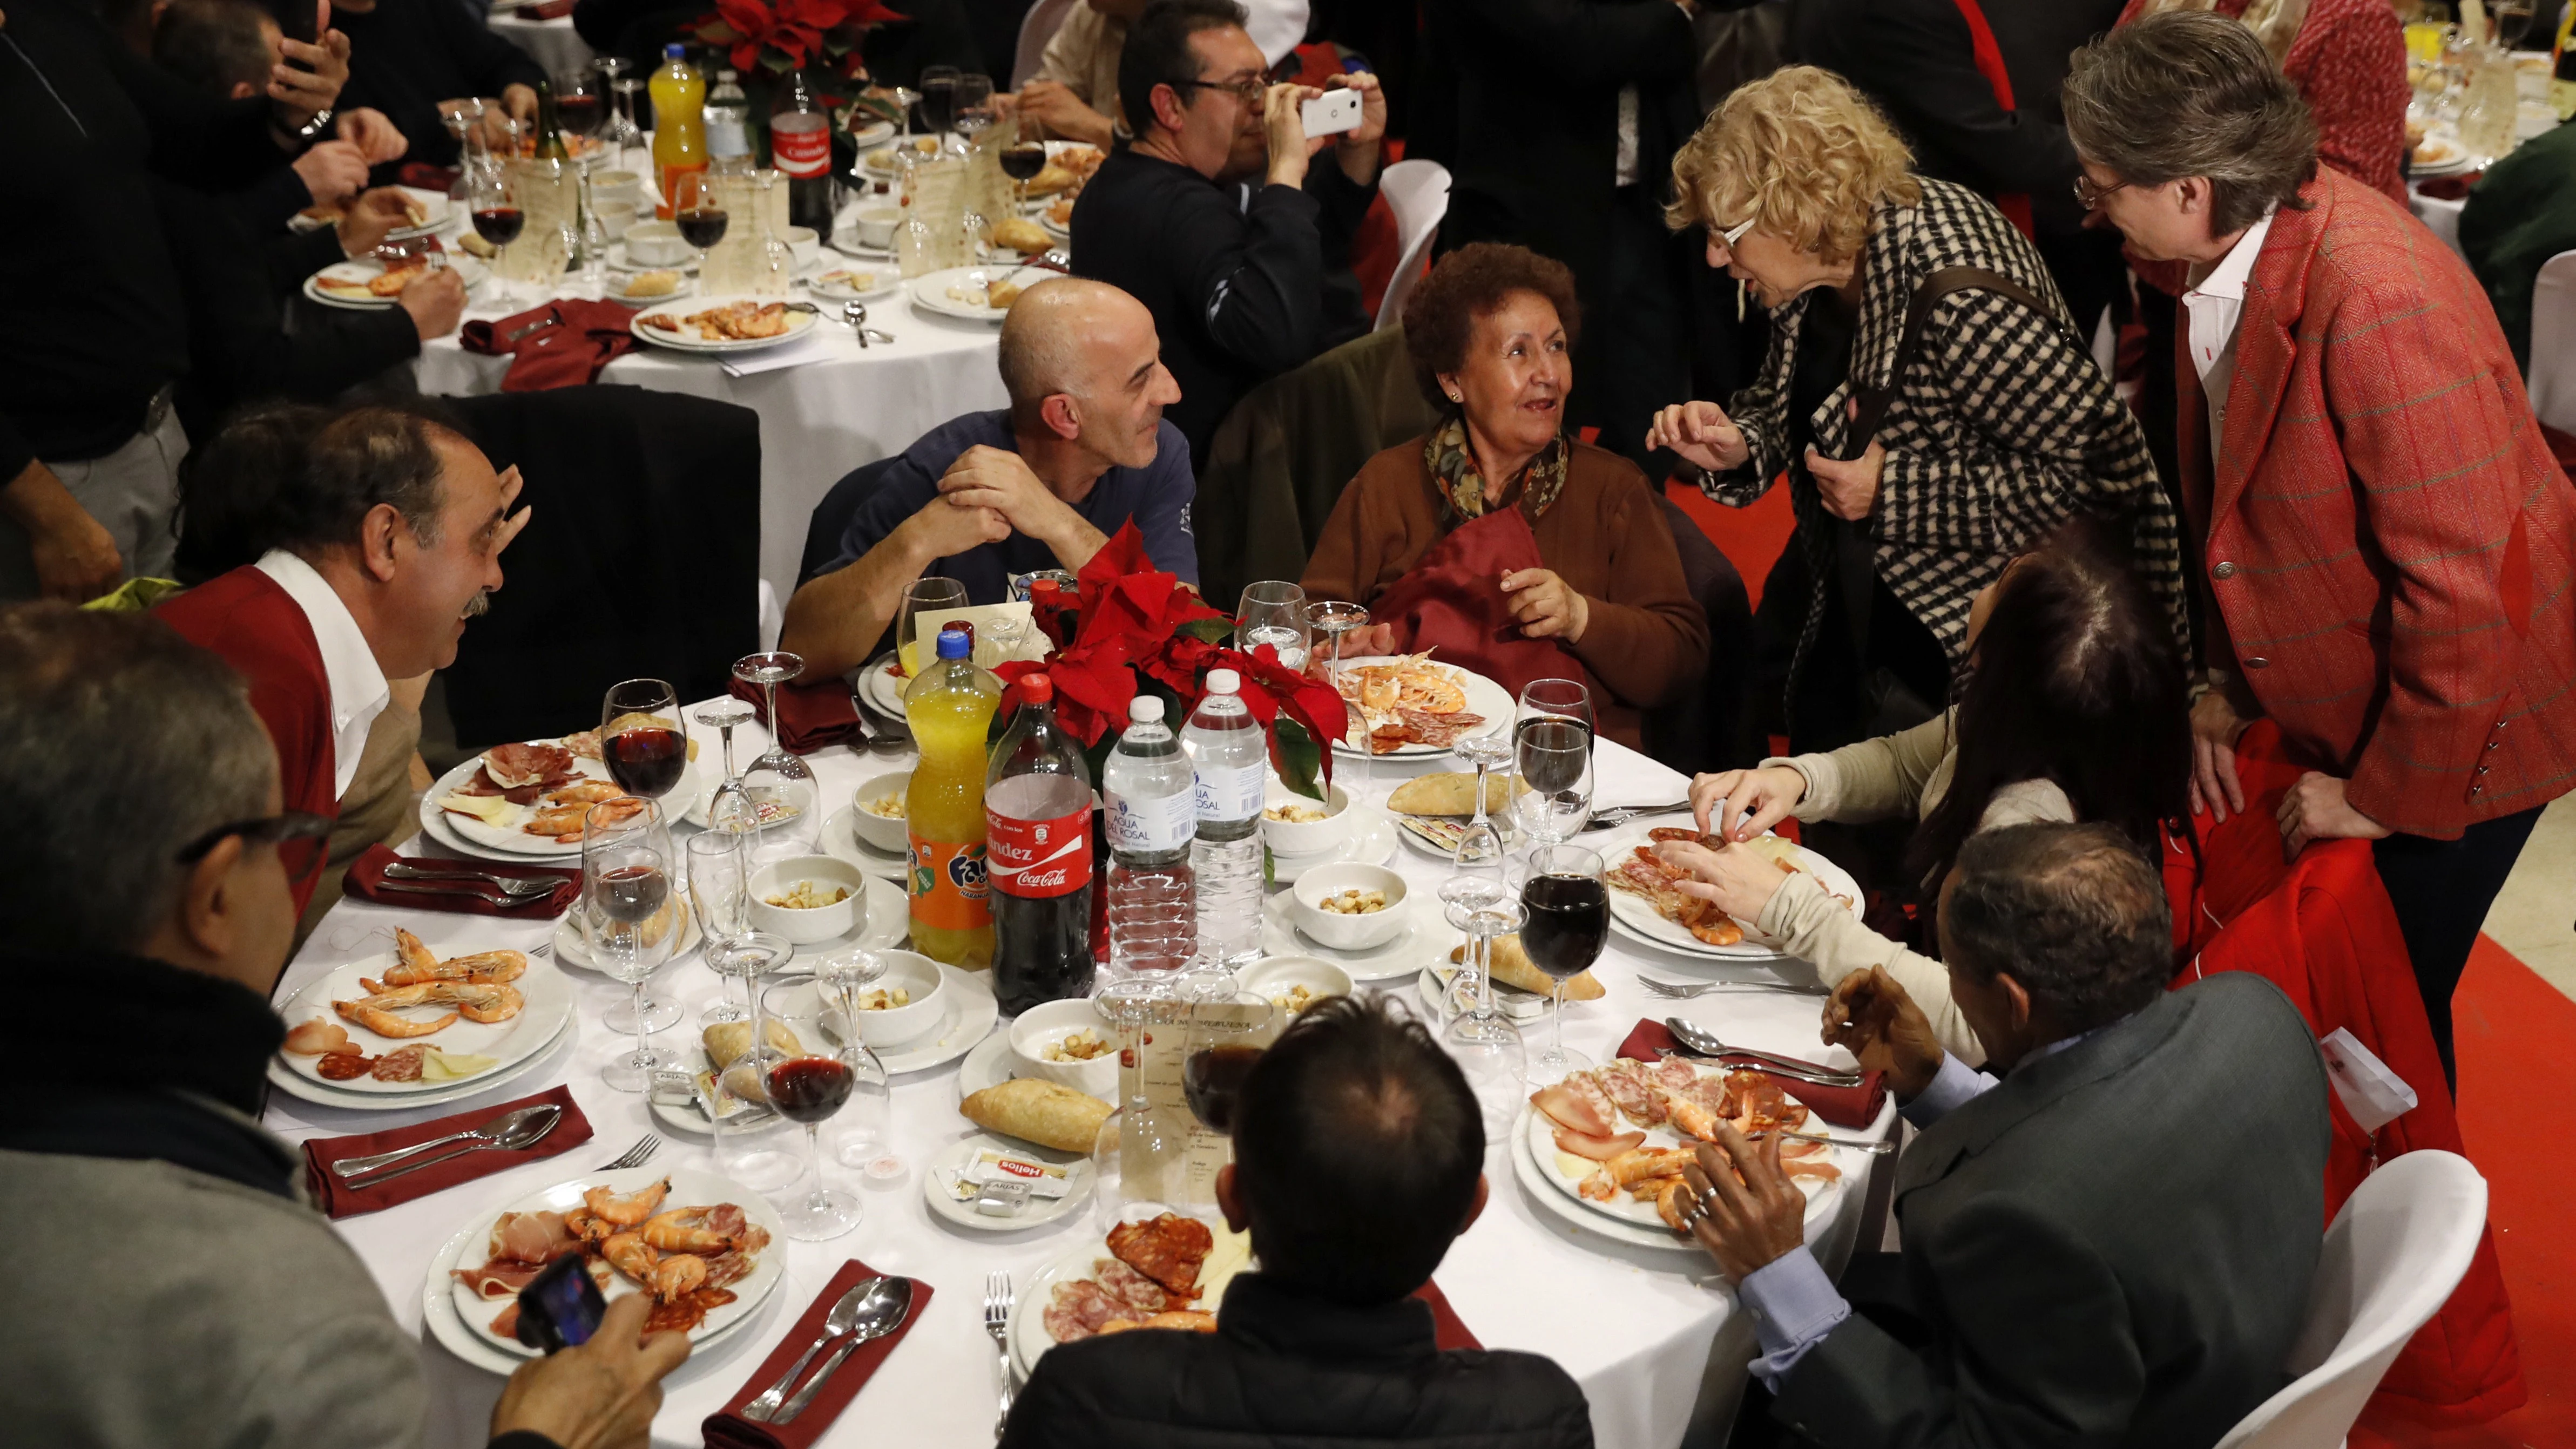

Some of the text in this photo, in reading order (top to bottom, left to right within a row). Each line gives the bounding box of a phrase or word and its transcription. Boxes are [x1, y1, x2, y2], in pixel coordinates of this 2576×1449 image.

[1196, 789, 1209, 799] UA
[1195, 799, 1220, 810] OSAL
[1114, 815, 1138, 829] AGUA
[1120, 827, 1150, 840] ROSAL
[1001, 1160, 1041, 1176] Helios
[994, 1182, 1020, 1191] ARIAS
